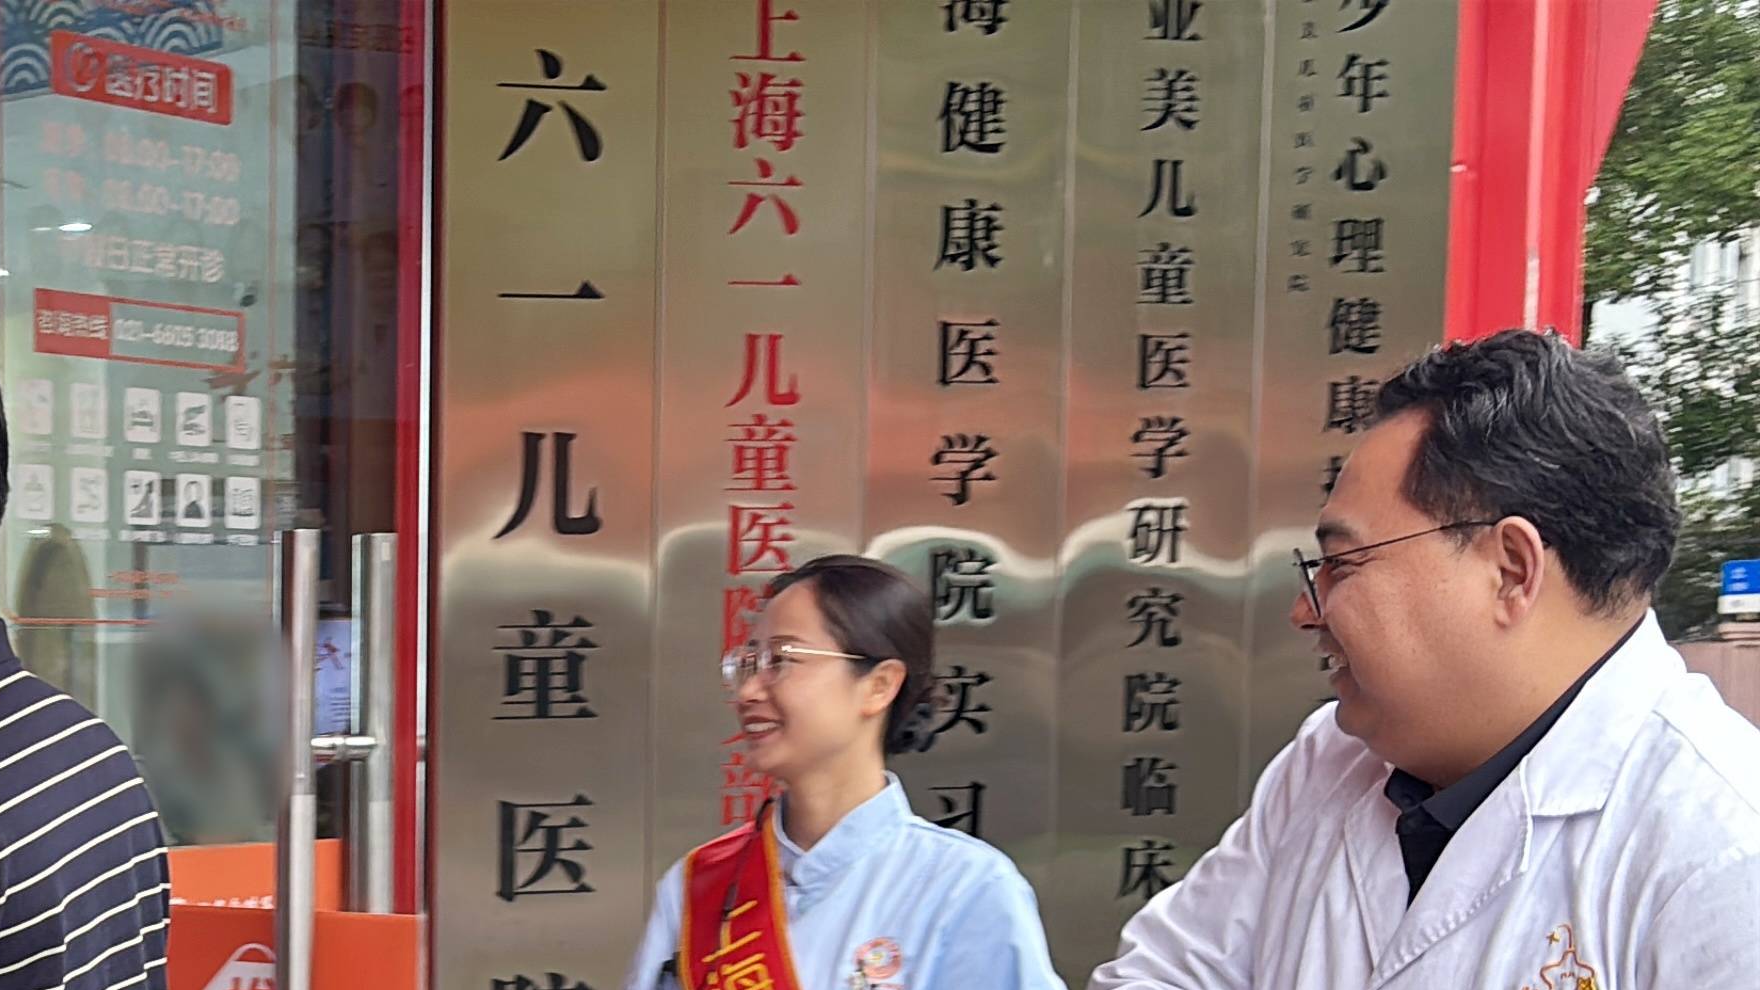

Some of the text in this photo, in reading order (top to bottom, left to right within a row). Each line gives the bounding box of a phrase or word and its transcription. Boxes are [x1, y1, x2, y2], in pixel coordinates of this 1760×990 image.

[720, 0, 806, 826] 上海六一儿童医部
[1321, 0, 1393, 493] 少年心理健康
